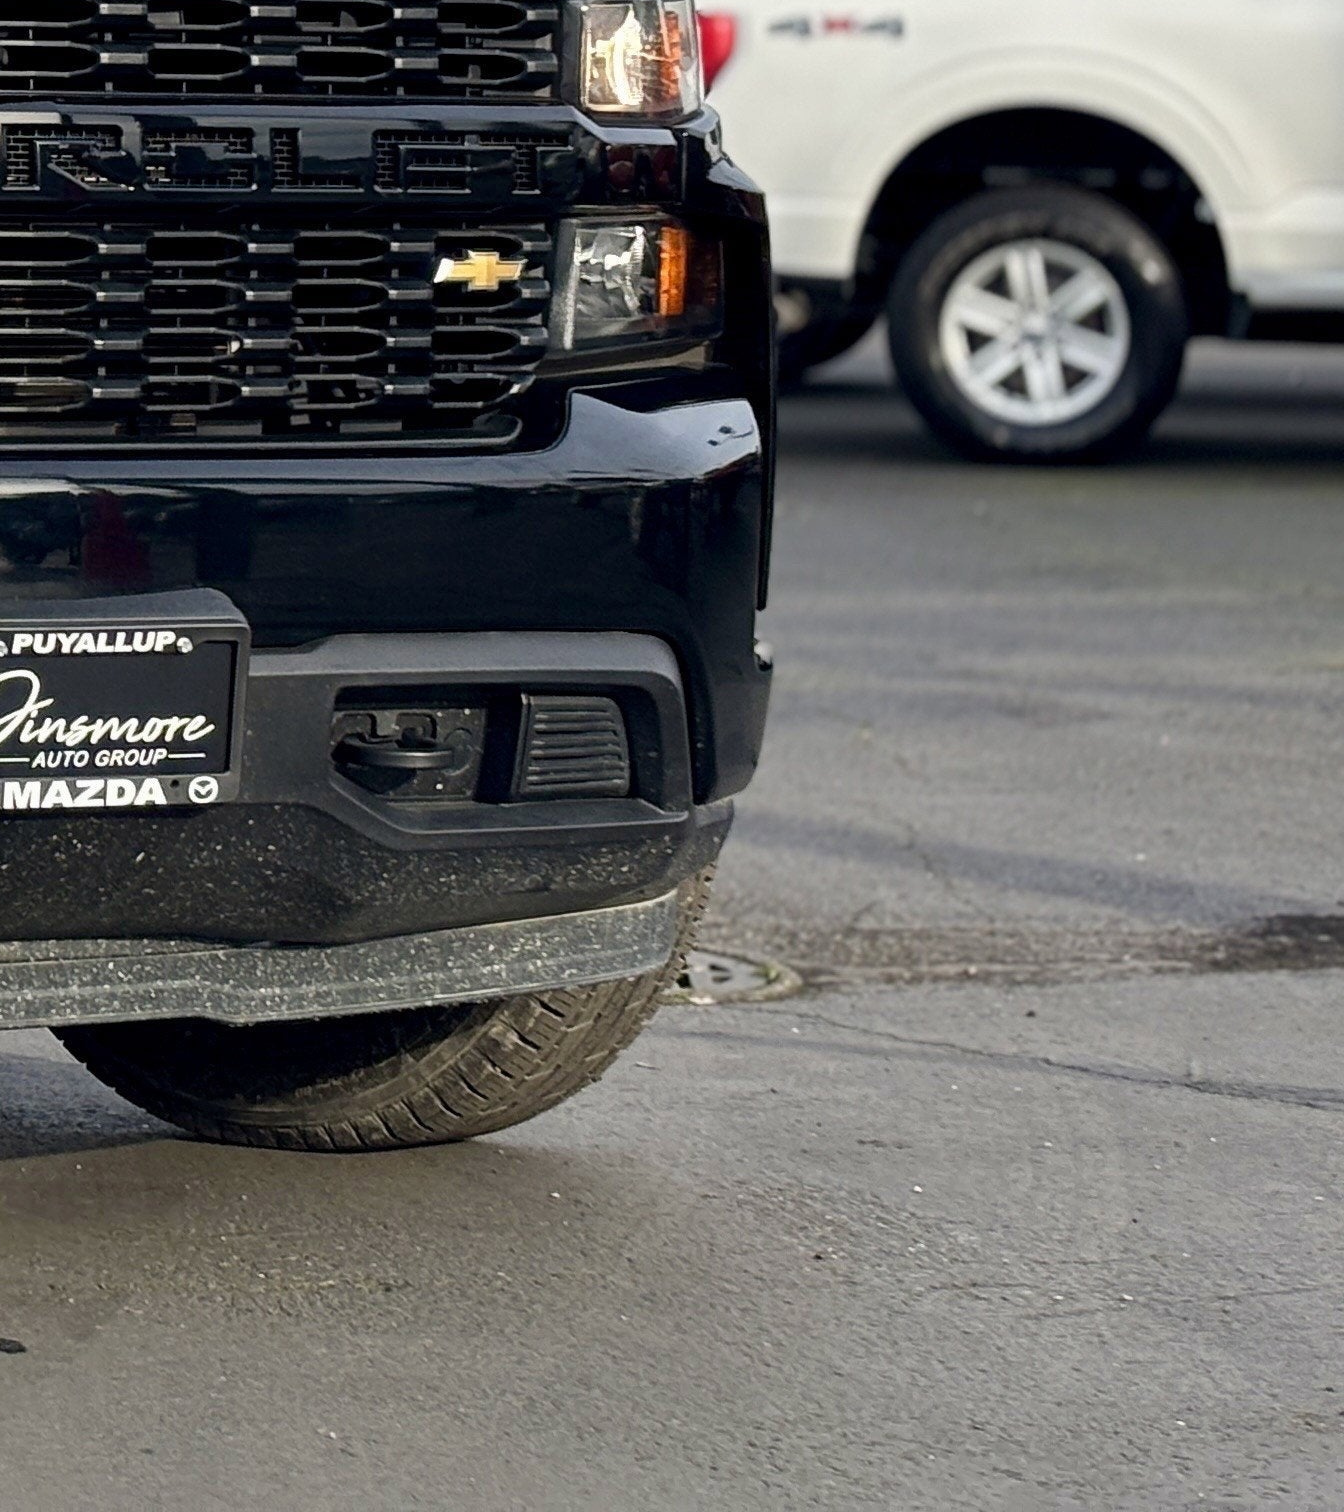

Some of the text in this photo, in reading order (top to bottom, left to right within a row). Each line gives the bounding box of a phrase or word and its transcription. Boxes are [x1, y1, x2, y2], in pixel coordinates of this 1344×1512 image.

[12, 631, 177, 654] PUYALLUP
[31, 748, 168, 768] AUTO GROUP
[2, 777, 168, 810] MAZDA
